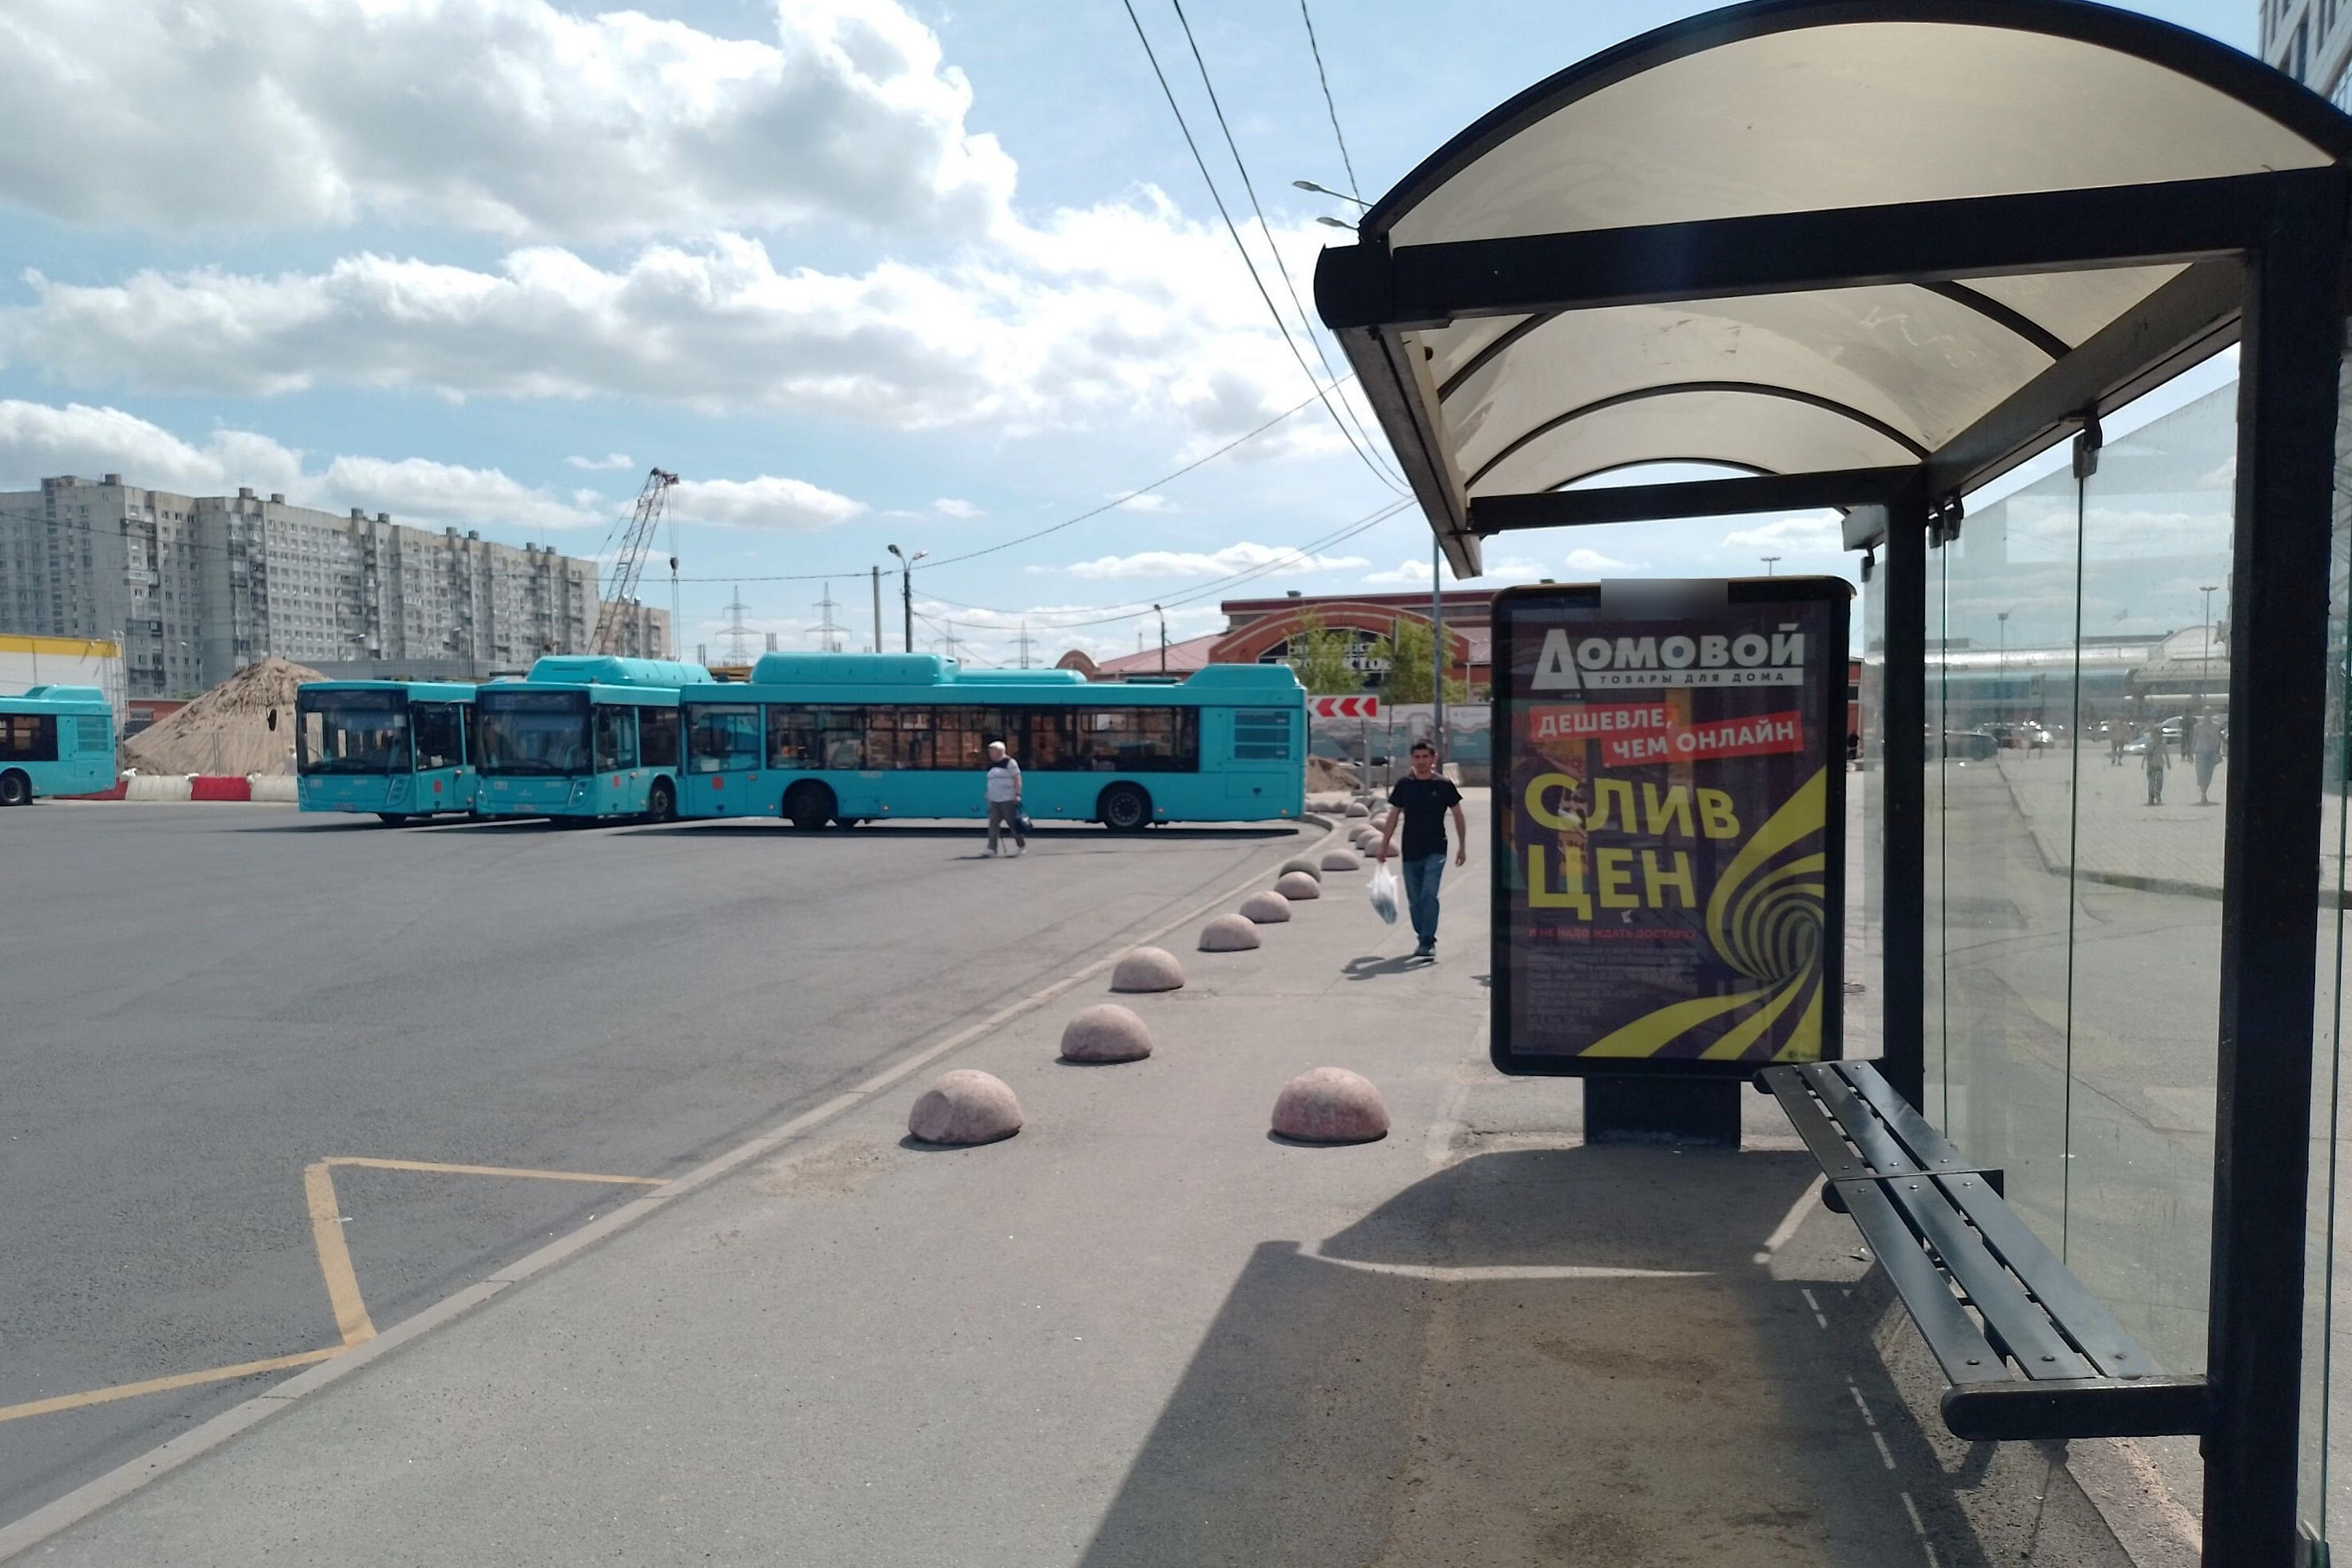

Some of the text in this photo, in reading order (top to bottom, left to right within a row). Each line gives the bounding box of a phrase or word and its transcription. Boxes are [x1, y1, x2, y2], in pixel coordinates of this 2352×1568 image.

[1599, 671, 1785, 685] ТОВАРЫ ДЛЯ ДОМА
[1538, 708, 1673, 738] ДЕШЕВЛЕ,
[1612, 718, 1795, 760] ЧЕМ ОНЛАЙН
[1523, 772, 1741, 839] СЛИВ
[1527, 843, 1697, 921] ЦЕН
[1540, 928, 1555, 938] НЕ
[1558, 928, 1590, 939] НАДО
[1594, 929, 1633, 939] ЖДАТЬ
[1635, 929, 1697, 940] ДОСТАВКУ
